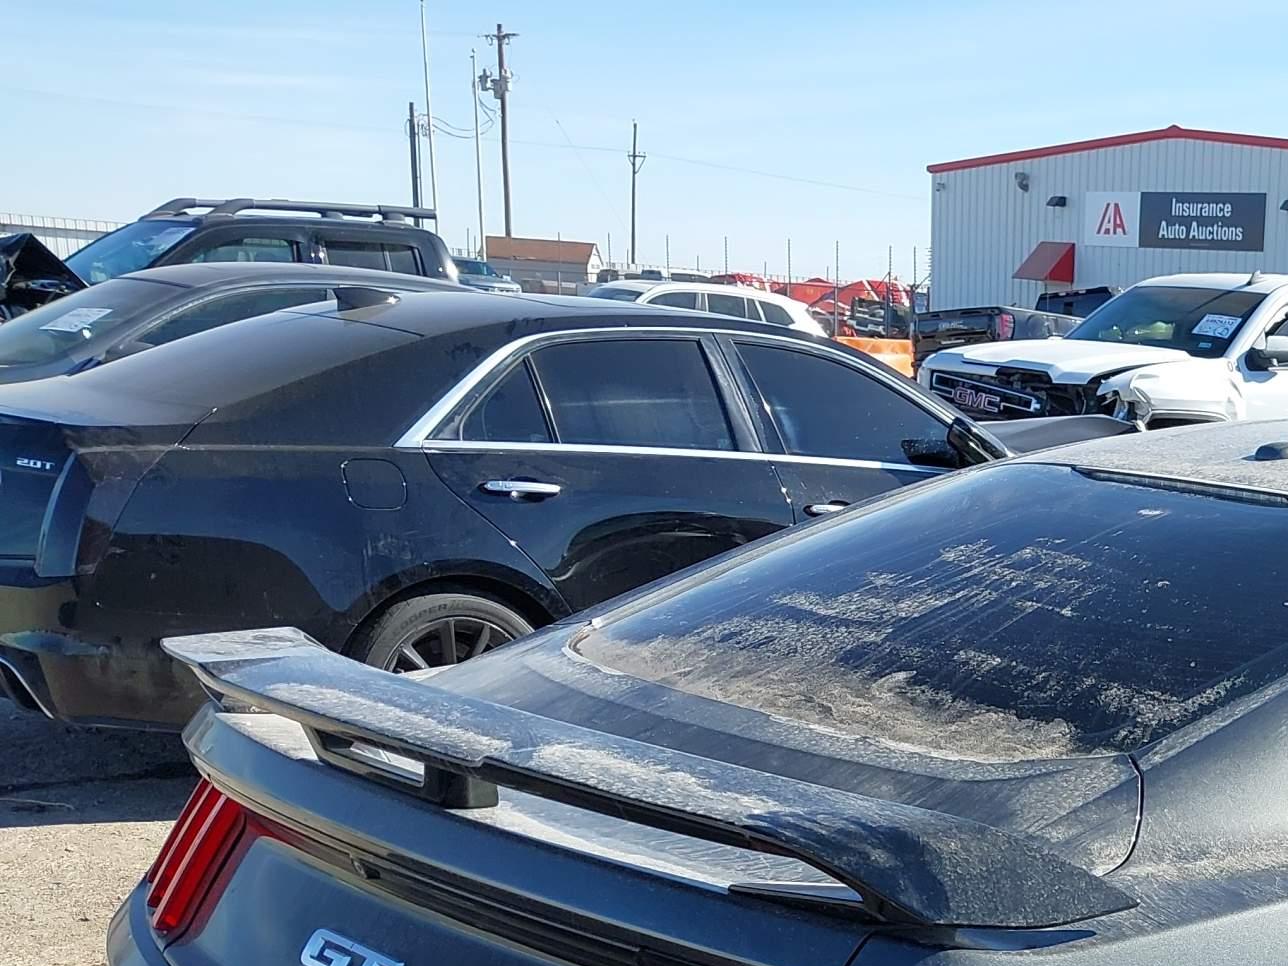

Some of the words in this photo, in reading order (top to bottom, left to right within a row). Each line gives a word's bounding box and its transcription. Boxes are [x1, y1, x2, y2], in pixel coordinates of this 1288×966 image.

[1171, 198, 1232, 217] Insurance
[1158, 220, 1186, 239] Auto
[1189, 221, 1243, 241] Auctions
[953, 386, 1000, 413] GMC
